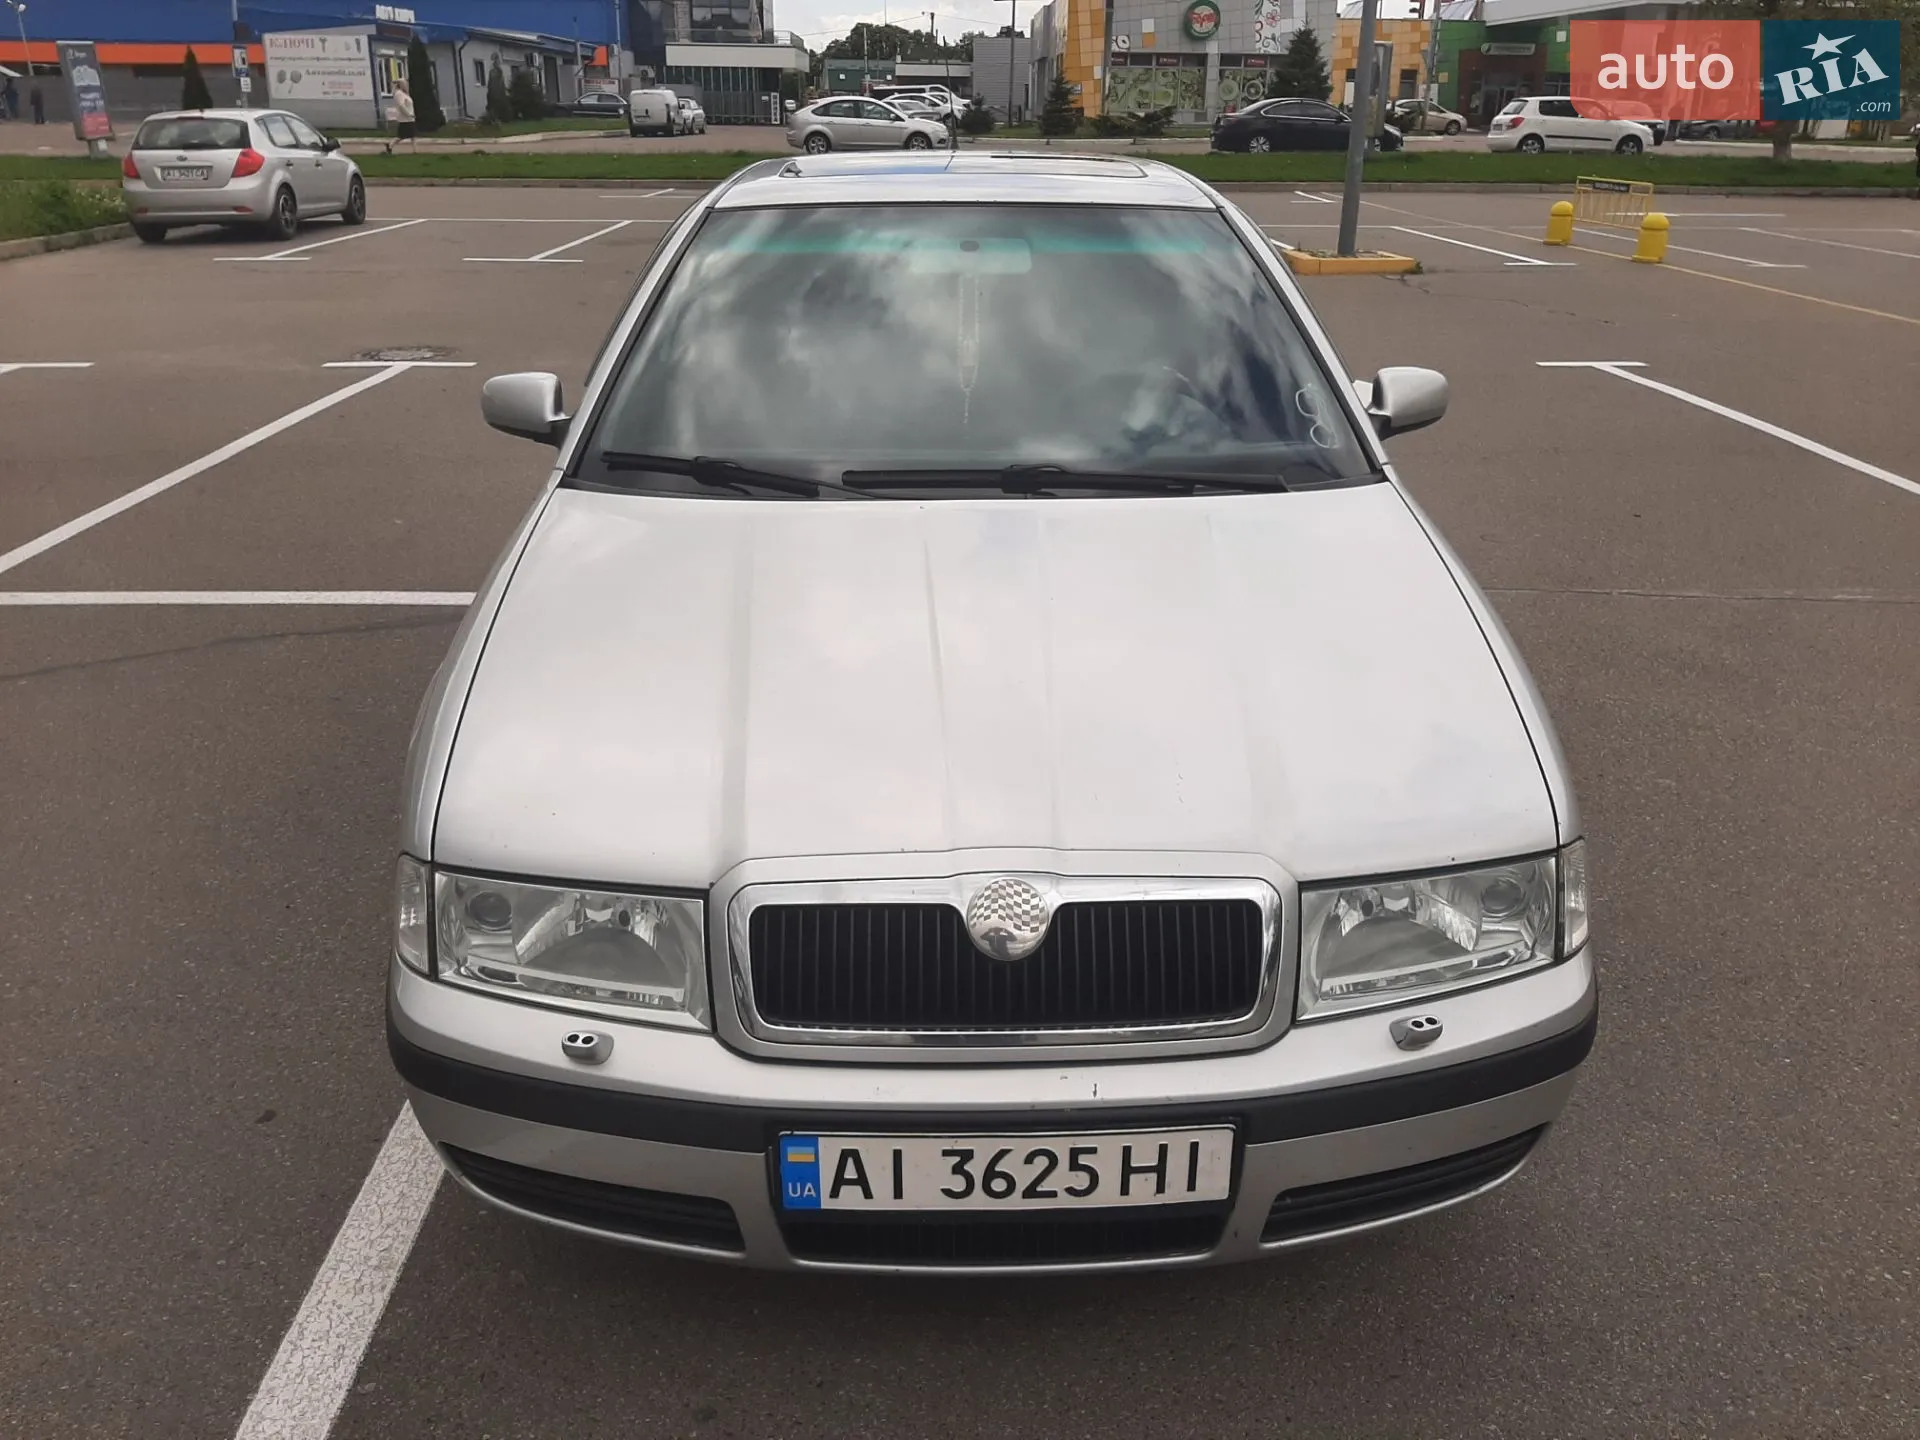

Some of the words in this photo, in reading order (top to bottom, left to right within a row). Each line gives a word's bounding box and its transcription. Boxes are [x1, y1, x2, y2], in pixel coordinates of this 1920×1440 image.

[829, 1147, 904, 1200] AI
[940, 1146, 1100, 1200] 3625
[1119, 1140, 1200, 1196] HI
[788, 1182, 817, 1198] UA
